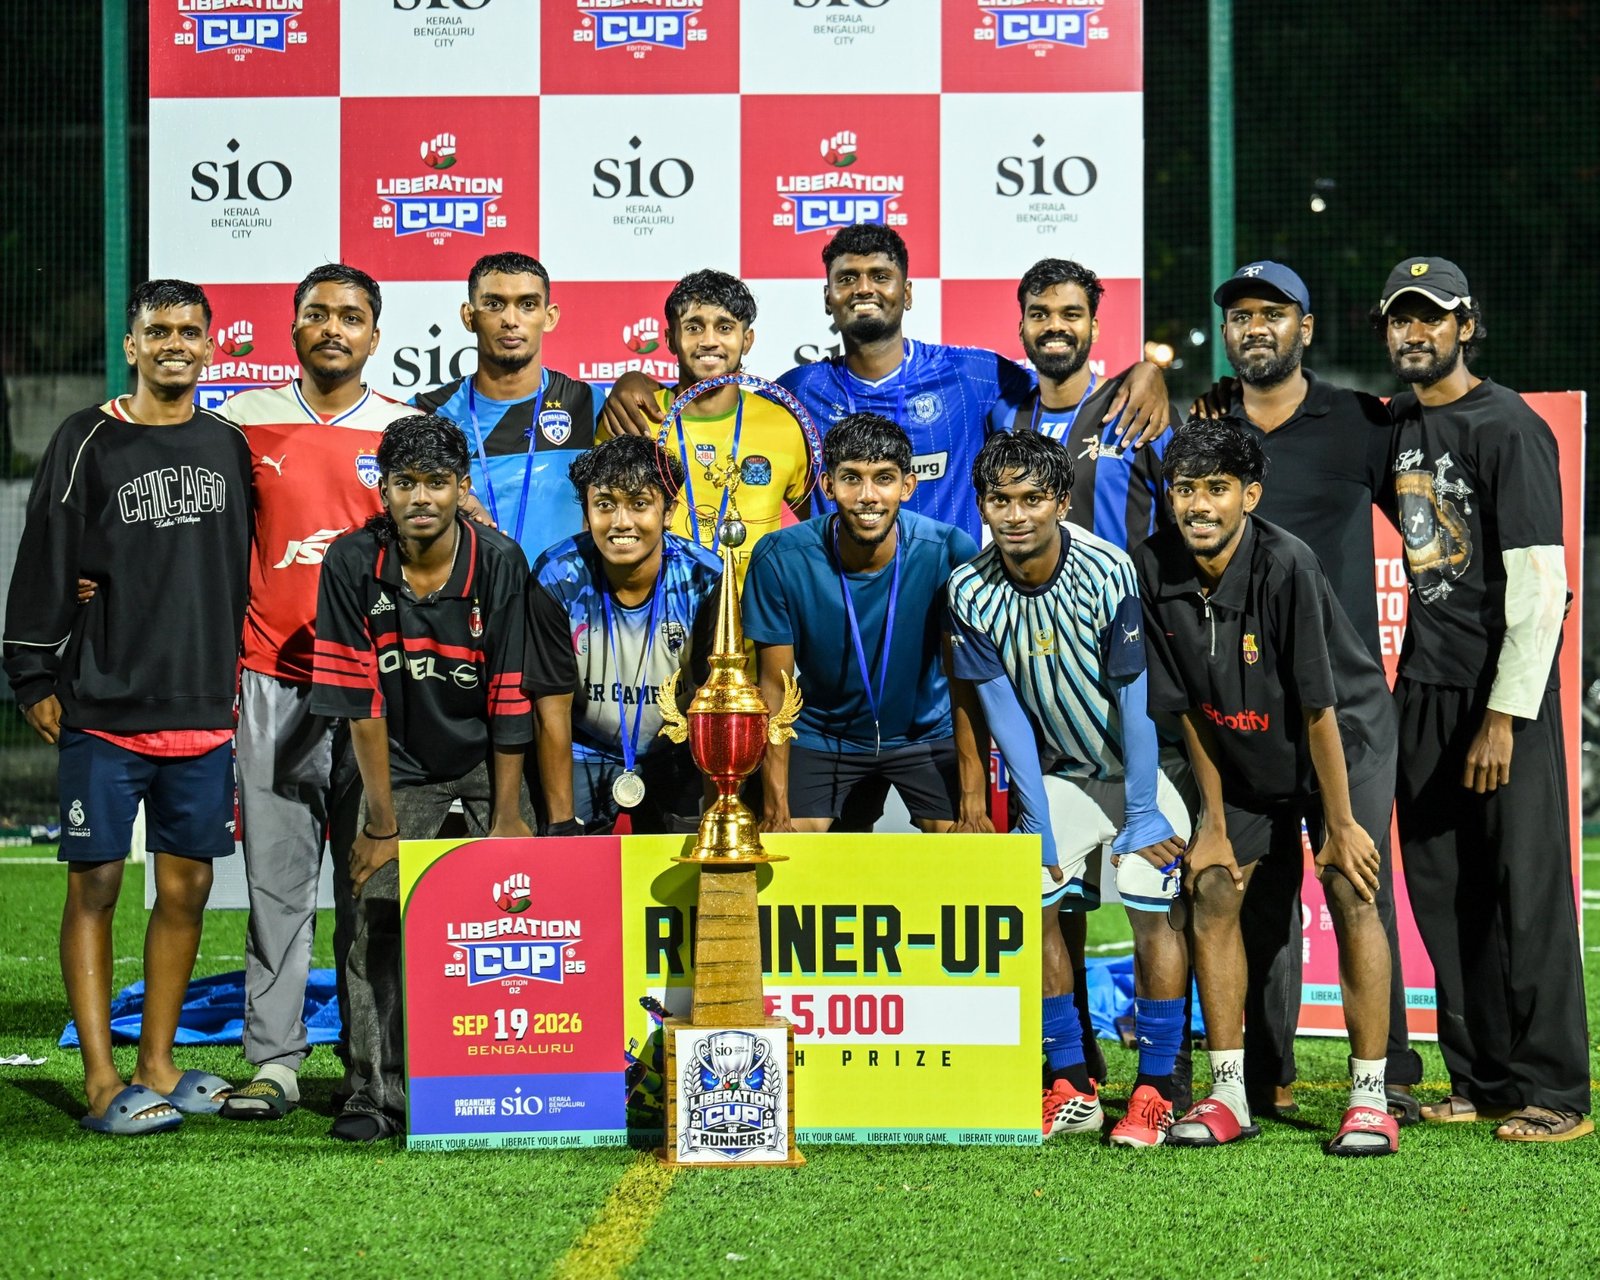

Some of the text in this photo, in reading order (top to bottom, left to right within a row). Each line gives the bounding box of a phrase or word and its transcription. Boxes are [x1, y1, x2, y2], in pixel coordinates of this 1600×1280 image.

[426, 17, 462, 25] KERALA
[826, 14, 862, 23] KERALA
[203, 19, 279, 45] CUP
[414, 27, 475, 36] BENGALURU
[602, 16, 679, 42] CUP
[813, 25, 875, 34] BENGALURU
[1003, 14, 1080, 40] CUP
[174, 33, 194, 45] 20
[287, 32, 307, 44] 26
[573, 30, 594, 41] 20
[687, 29, 707, 41] 26
[834, 36, 854, 45] CITY
[974, 28, 994, 40] 20
[434, 39, 454, 47] CITY
[191, 138, 293, 201] sio
[593, 135, 694, 199] sio
[996, 133, 1097, 197] sio
[376, 174, 503, 195] LIBERATION
[776, 172, 904, 192] LIBERATION
[224, 207, 260, 216] KERALA
[625, 205, 662, 213] KERALA
[802, 200, 879, 226] CUP
[1028, 203, 1066, 211] KERALA
[211, 218, 272, 227] BENGALURU
[373, 216, 393, 229] 20
[401, 203, 479, 229] CUP
[486, 215, 507, 228] 26
[613, 216, 675, 225] BENGALURU
[773, 213, 793, 226] 20
[887, 213, 908, 226] 26
[1016, 214, 1078, 223] BENGALURU
[231, 229, 252, 239] CITY
[633, 227, 654, 236] CITY
[1036, 225, 1057, 234] CITY
[198, 362, 300, 382] ERATION
[579, 359, 680, 379] LIBERATI
[911, 461, 940, 476] urg
[118, 466, 226, 523] CHICAGO
[273, 540, 332, 569] JS
[371, 604, 396, 615] addas
[1202, 703, 1269, 732] Spotify
[447, 917, 581, 940] LIBERATION
[645, 905, 1024, 978] RNER-UP
[475, 946, 555, 975] CUP
[445, 964, 466, 977] 20
[565, 961, 586, 974] 26
[509, 987, 521, 995] 02
[1311, 990, 1342, 1001] LIBERA
[1407, 994, 1437, 1005] LIBERA
[453, 1008, 582, 1041] SEP 19 2026
[467, 1043, 575, 1056] BENGALURU
[842, 1050, 951, 1067] PRIZE
[454, 1098, 496, 1107] ORGANIZING
[501, 1087, 543, 1116] sio
[690, 1090, 775, 1111] LIBERATION
[454, 1106, 496, 1117] PARTNER
[705, 1105, 760, 1126] CUP
[1353, 1112, 1384, 1125] NIKE
[410, 1138, 491, 1150] LIBERATE YOUR GAME.
[502, 1135, 583, 1147] LIBERATE YOUR GAME.
[594, 1135, 627, 1145] LIBERATE
[700, 1132, 766, 1147] RUNNERS
[812, 1133, 832, 1142] YOUR
[834, 1133, 857, 1142] GAME.
[868, 1133, 949, 1143] LIBERATE YOUR GAME.
[959, 1133, 1040, 1144] LIBERATE YOUR GAME.
